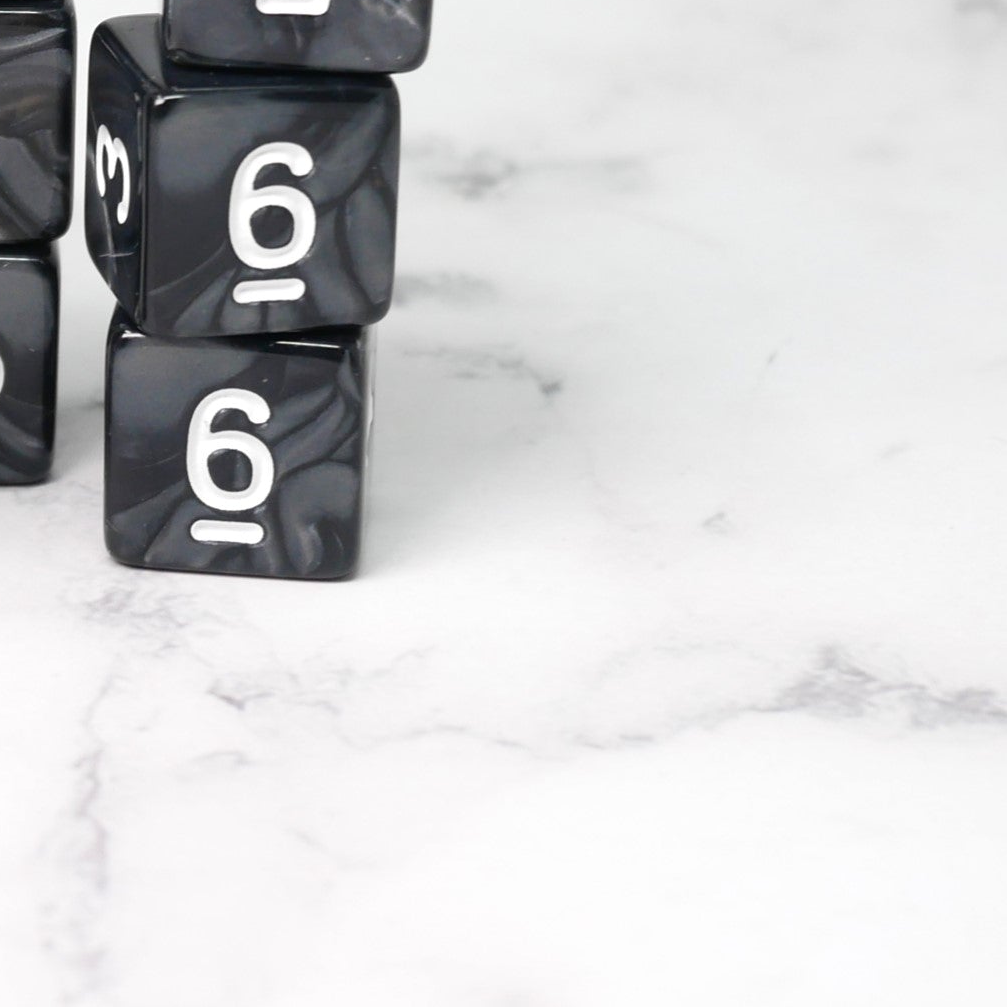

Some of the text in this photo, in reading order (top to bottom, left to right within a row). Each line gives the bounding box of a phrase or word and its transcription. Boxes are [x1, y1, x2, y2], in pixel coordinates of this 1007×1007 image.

[95, 124, 131, 226] 3
[228, 141, 317, 304] 6
[186, 387, 275, 546] 6
